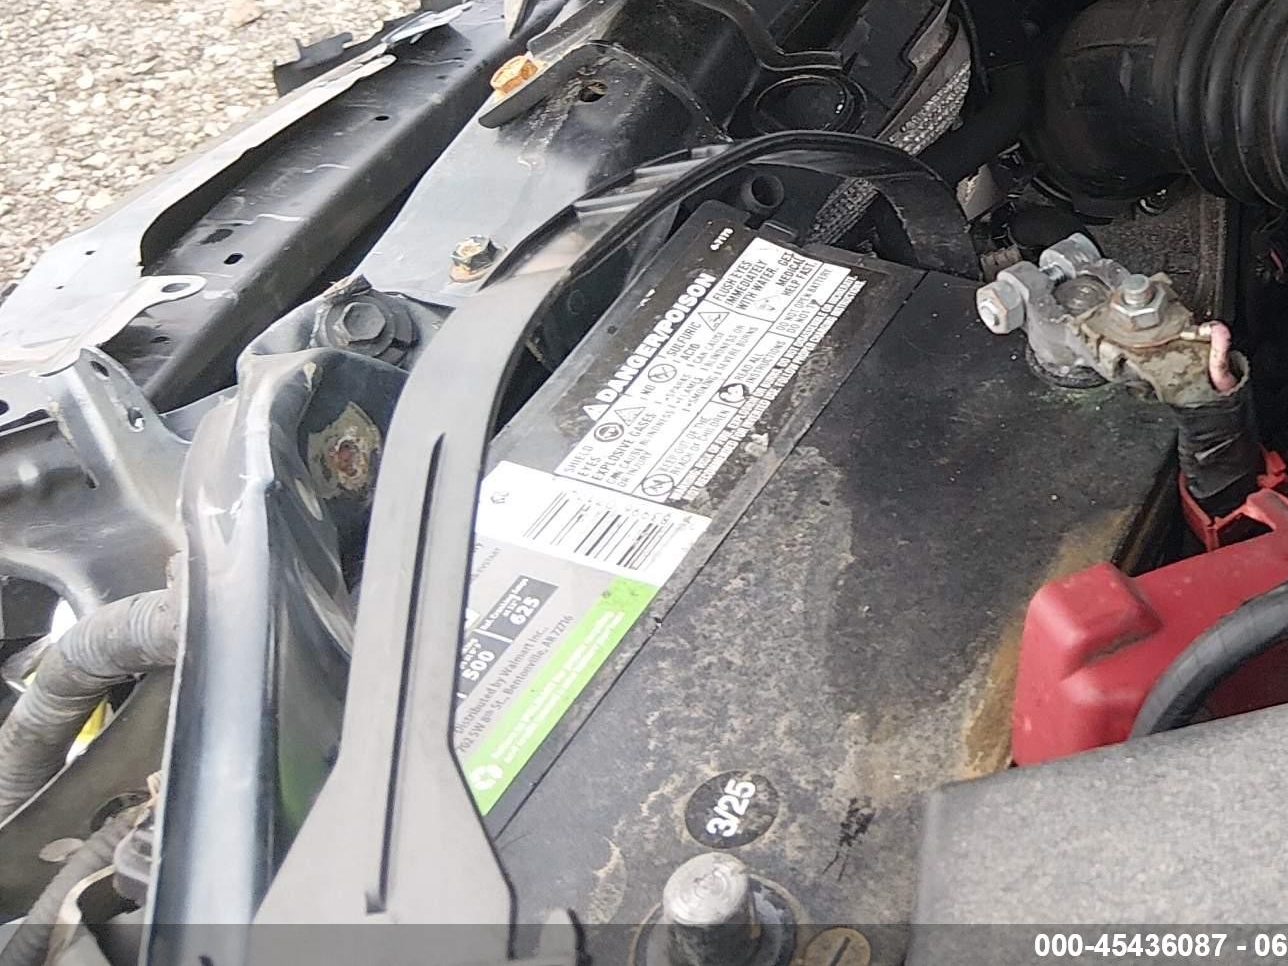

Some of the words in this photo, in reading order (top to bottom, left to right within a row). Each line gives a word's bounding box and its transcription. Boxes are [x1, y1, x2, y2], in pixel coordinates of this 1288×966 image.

[773, 256, 807, 286] MEDICAL
[775, 251, 796, 267] GET
[711, 277, 739, 301] FLUSH
[729, 259, 754, 279] EYES
[721, 258, 770, 306] IMMEDIATELY
[780, 278, 803, 297] HELP
[734, 290, 759, 310] WITH
[775, 320, 790, 331] DO
[783, 307, 800, 321] NOT
[785, 322, 800, 333] DO
[595, 272, 717, 403] DANGER/POISON
[664, 320, 703, 356] SULFURIC
[677, 341, 701, 360] ACID
[732, 362, 755, 381] READ
[742, 339, 787, 384] INSTRUCTIONS
[638, 383, 657, 396] NO
[561, 444, 595, 473] SHIELD
[590, 436, 637, 481] EXPLOSIVE
[628, 411, 658, 437] GASES
[575, 455, 603, 477] EYES
[626, 450, 653, 473] INJURY
[510, 596, 540, 625] 625
[461, 650, 495, 681] 500
[454, 683, 497, 734] Distributed
[494, 675, 506, 688] by
[500, 640, 533, 678] Walmart
[457, 737, 475, 754] 702
[470, 721, 487, 738] SW
[503, 646, 550, 697] Bentonville,
[706, 778, 756, 838] 3/25
